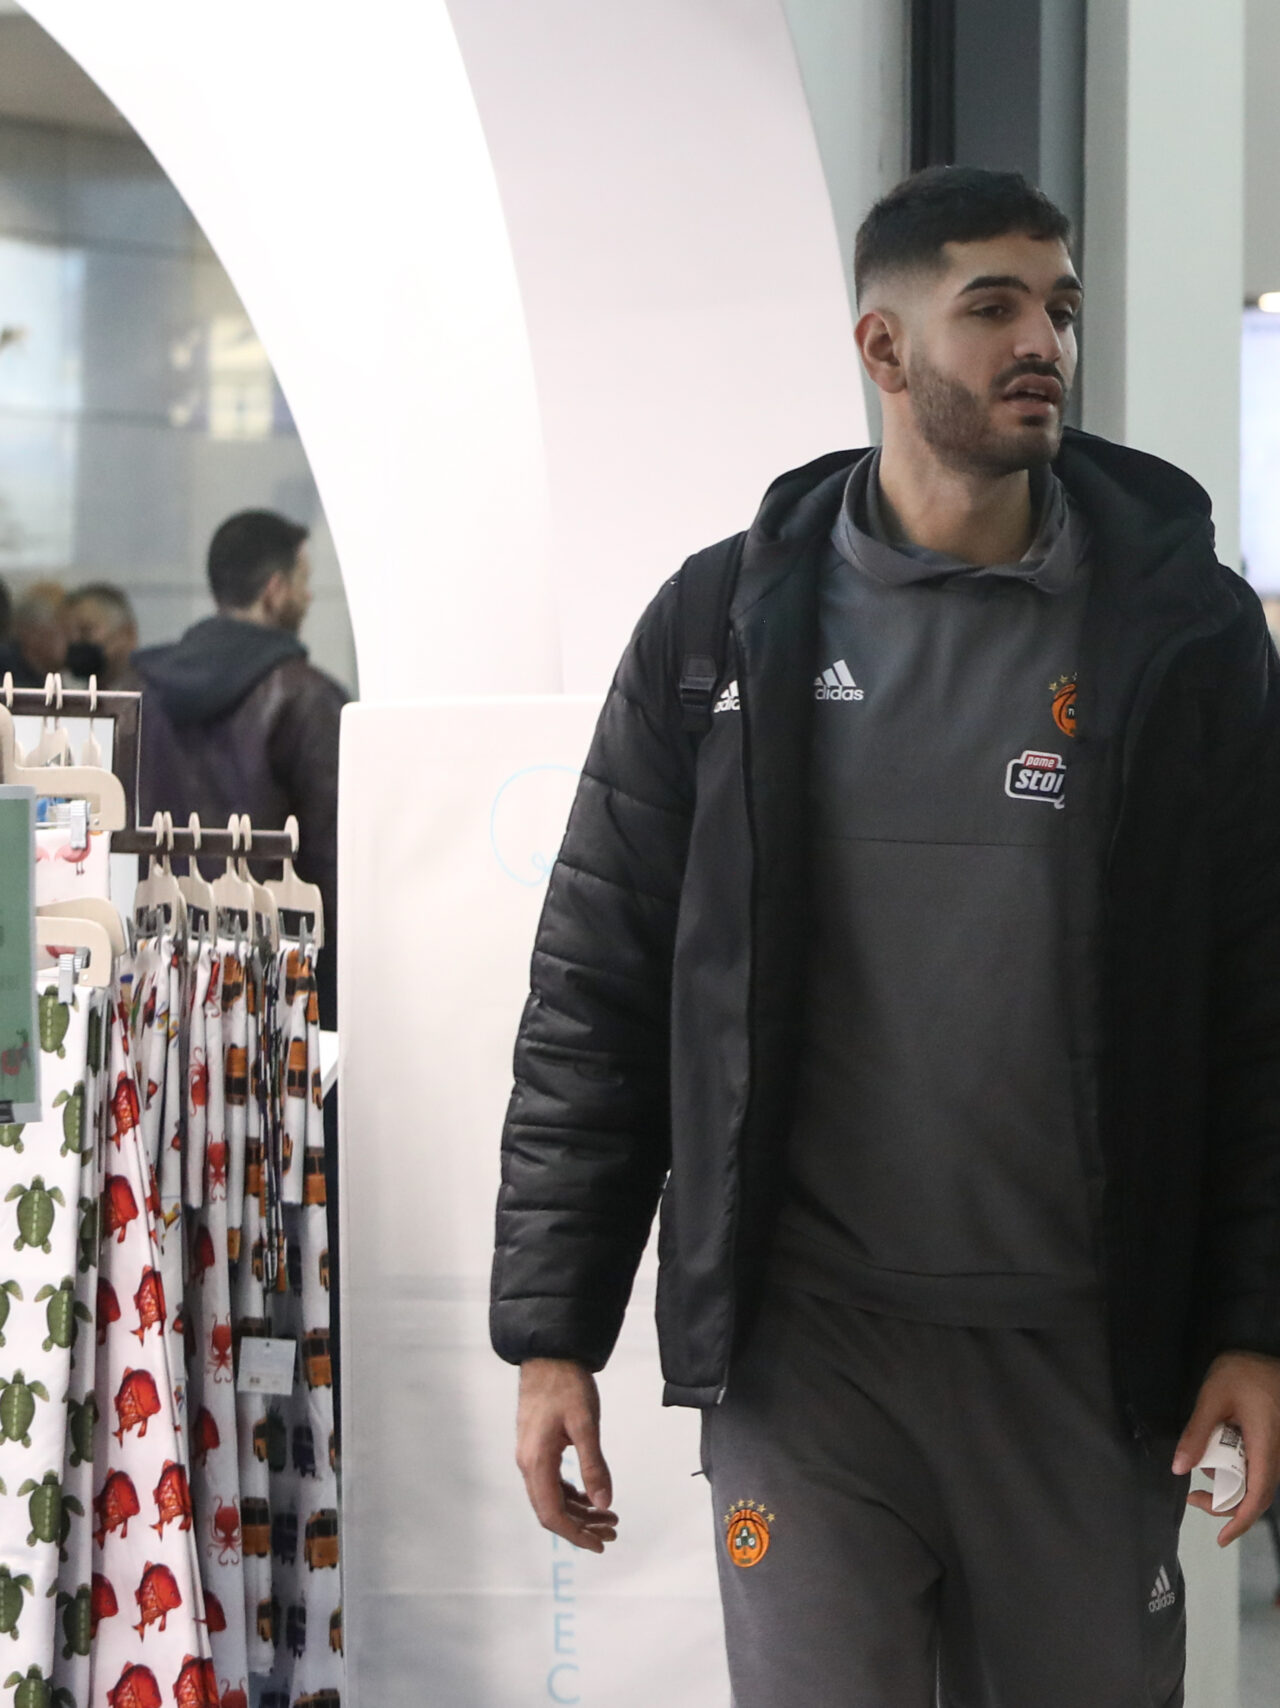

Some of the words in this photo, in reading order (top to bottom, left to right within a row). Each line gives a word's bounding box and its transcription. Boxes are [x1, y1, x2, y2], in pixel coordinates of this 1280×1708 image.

[815, 685, 864, 701] didas
[1026, 756, 1056, 769] pame
[1148, 1591, 1175, 1612] adidas
